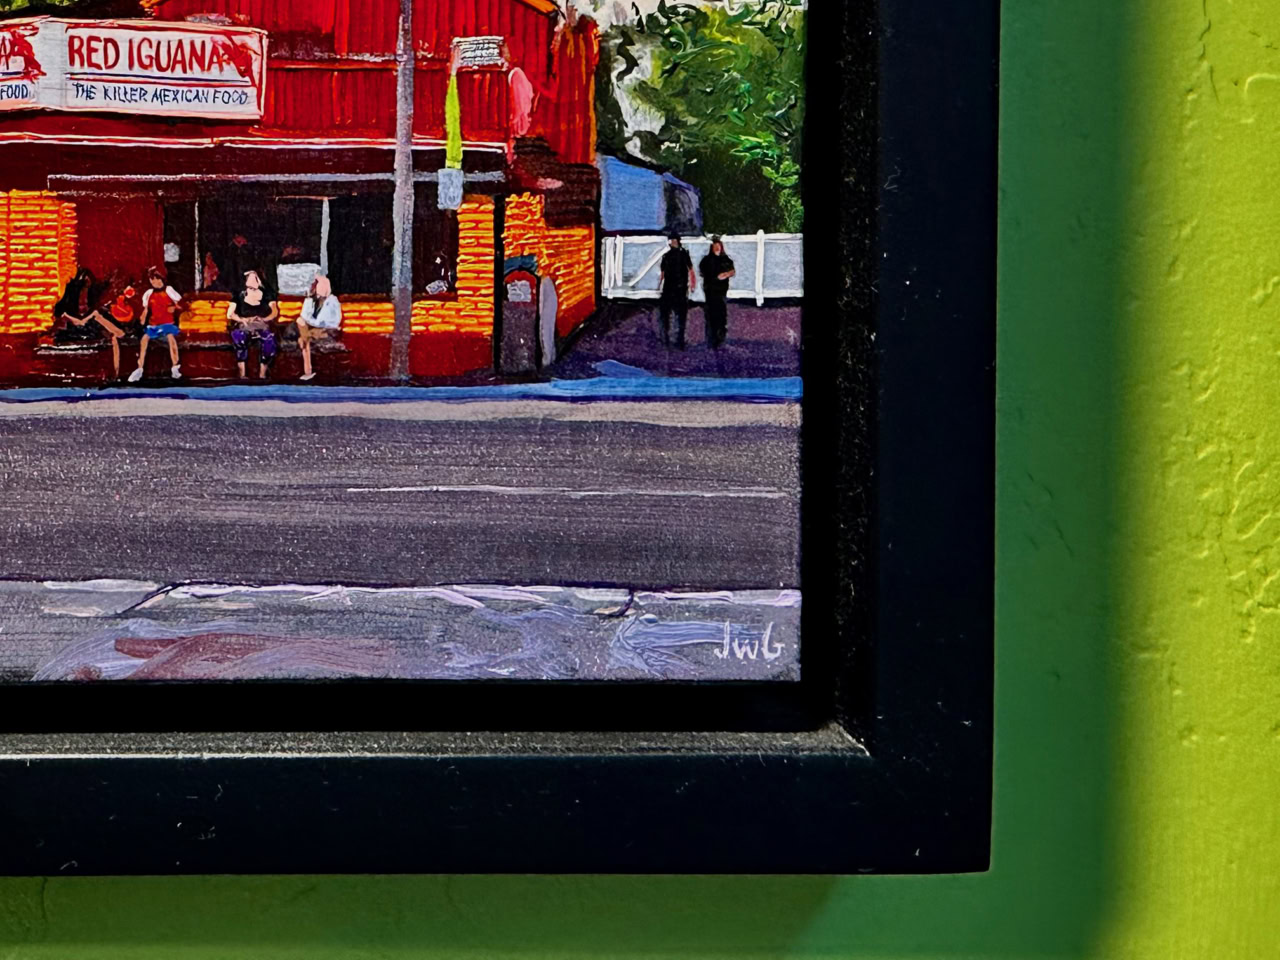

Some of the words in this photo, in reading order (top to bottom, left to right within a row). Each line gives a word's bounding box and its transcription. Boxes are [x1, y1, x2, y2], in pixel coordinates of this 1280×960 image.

[68, 35, 120, 70] RED
[128, 36, 224, 74] IGUANA
[0, 83, 28, 100] FOOD
[73, 82, 97, 100] THE
[103, 84, 148, 103] KILLER
[151, 87, 209, 105] MEXICAN
[213, 89, 248, 104] FOOD
